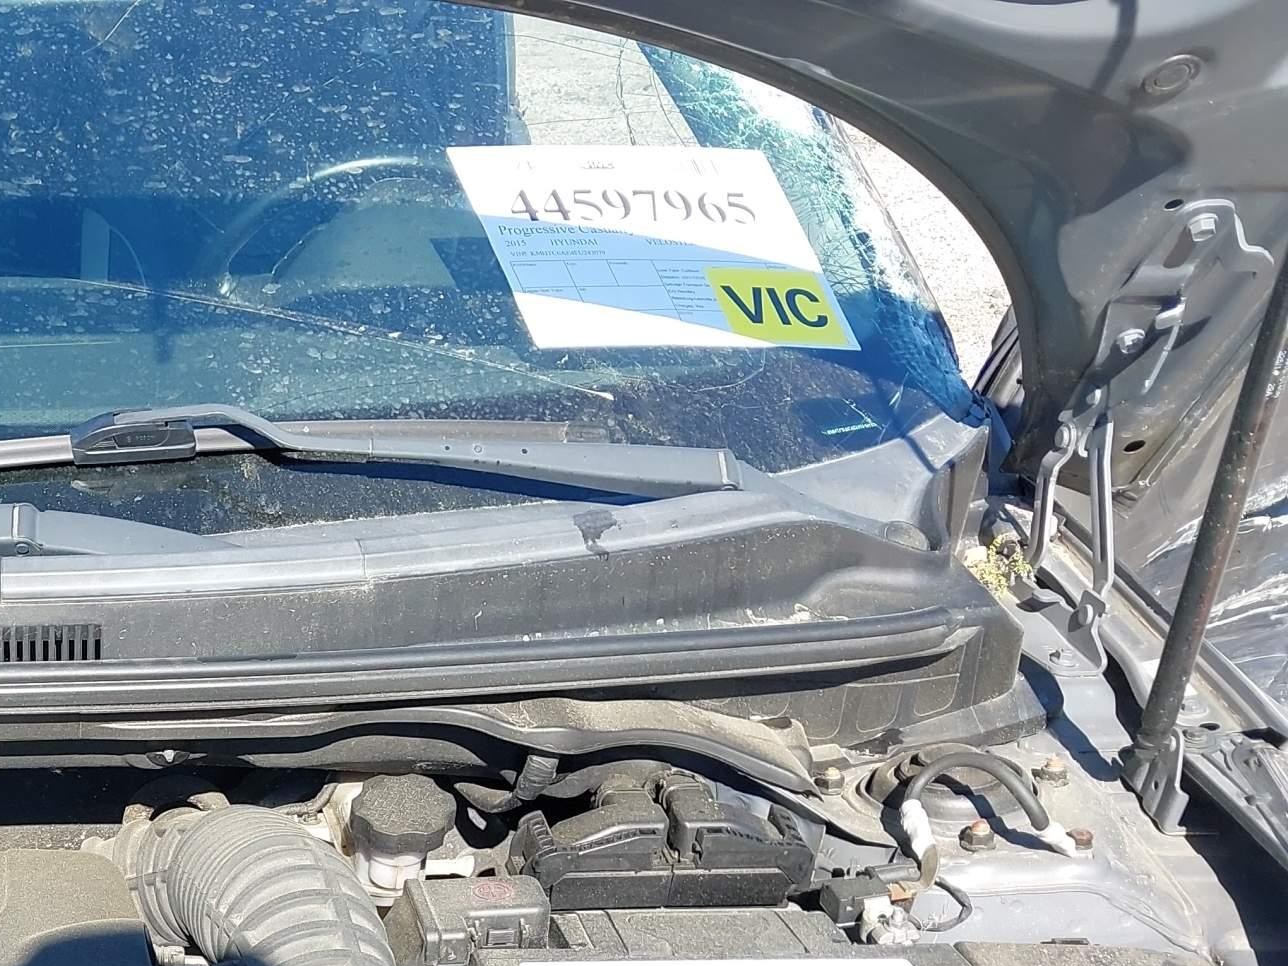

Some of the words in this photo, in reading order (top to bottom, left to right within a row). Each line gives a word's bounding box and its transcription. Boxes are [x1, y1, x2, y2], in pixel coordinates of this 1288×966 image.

[510, 188, 756, 225] 44597965
[498, 224, 575, 237] Progressive
[505, 239, 527, 248] 2015
[550, 238, 599, 247] HYUNDAI
[720, 285, 829, 328] VIC
